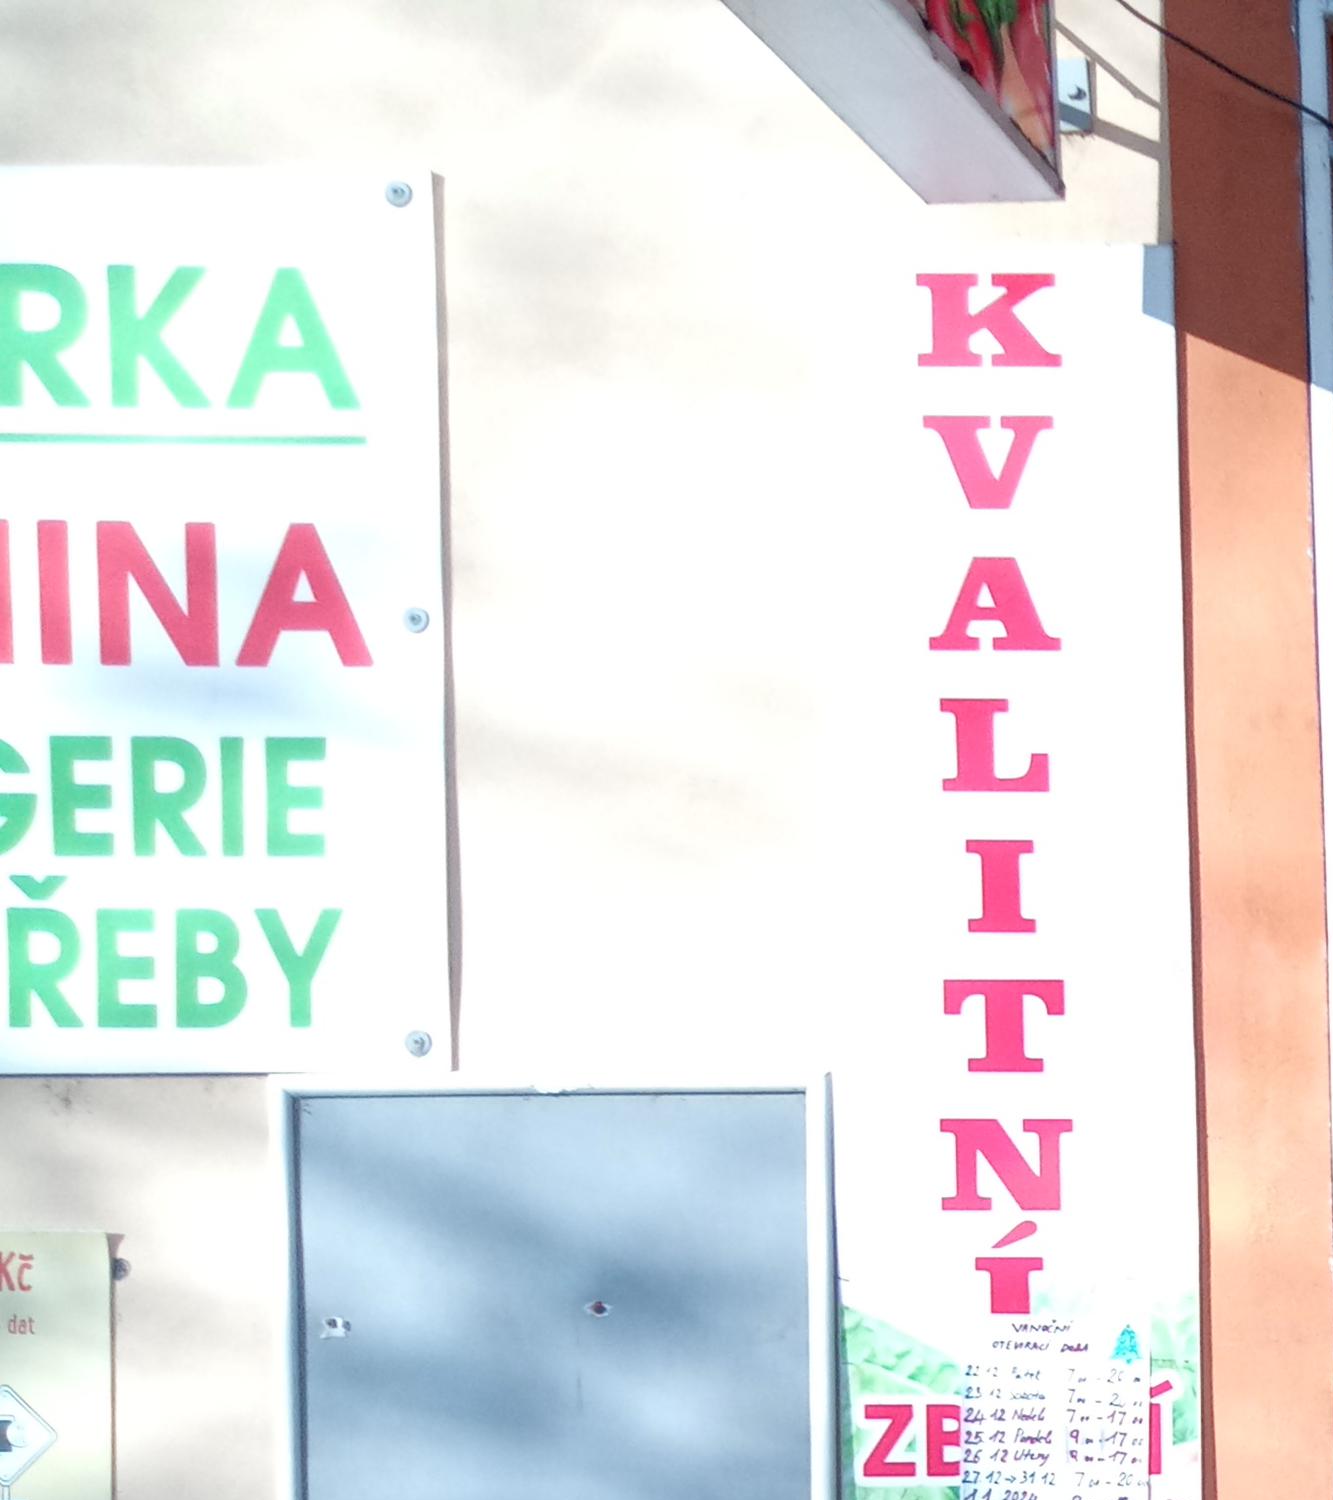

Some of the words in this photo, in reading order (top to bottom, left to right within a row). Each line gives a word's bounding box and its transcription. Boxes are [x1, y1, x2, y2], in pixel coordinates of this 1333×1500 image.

[0, 518, 375, 668] INA
[915, 272, 1074, 1315] KVALITNÍ
[5, 874, 343, 1029] ŘEBY
[0, 1250, 34, 1292] Kč
[7, 1312, 36, 1335] dat
[863, 1379, 1174, 1477] ZBÍ
